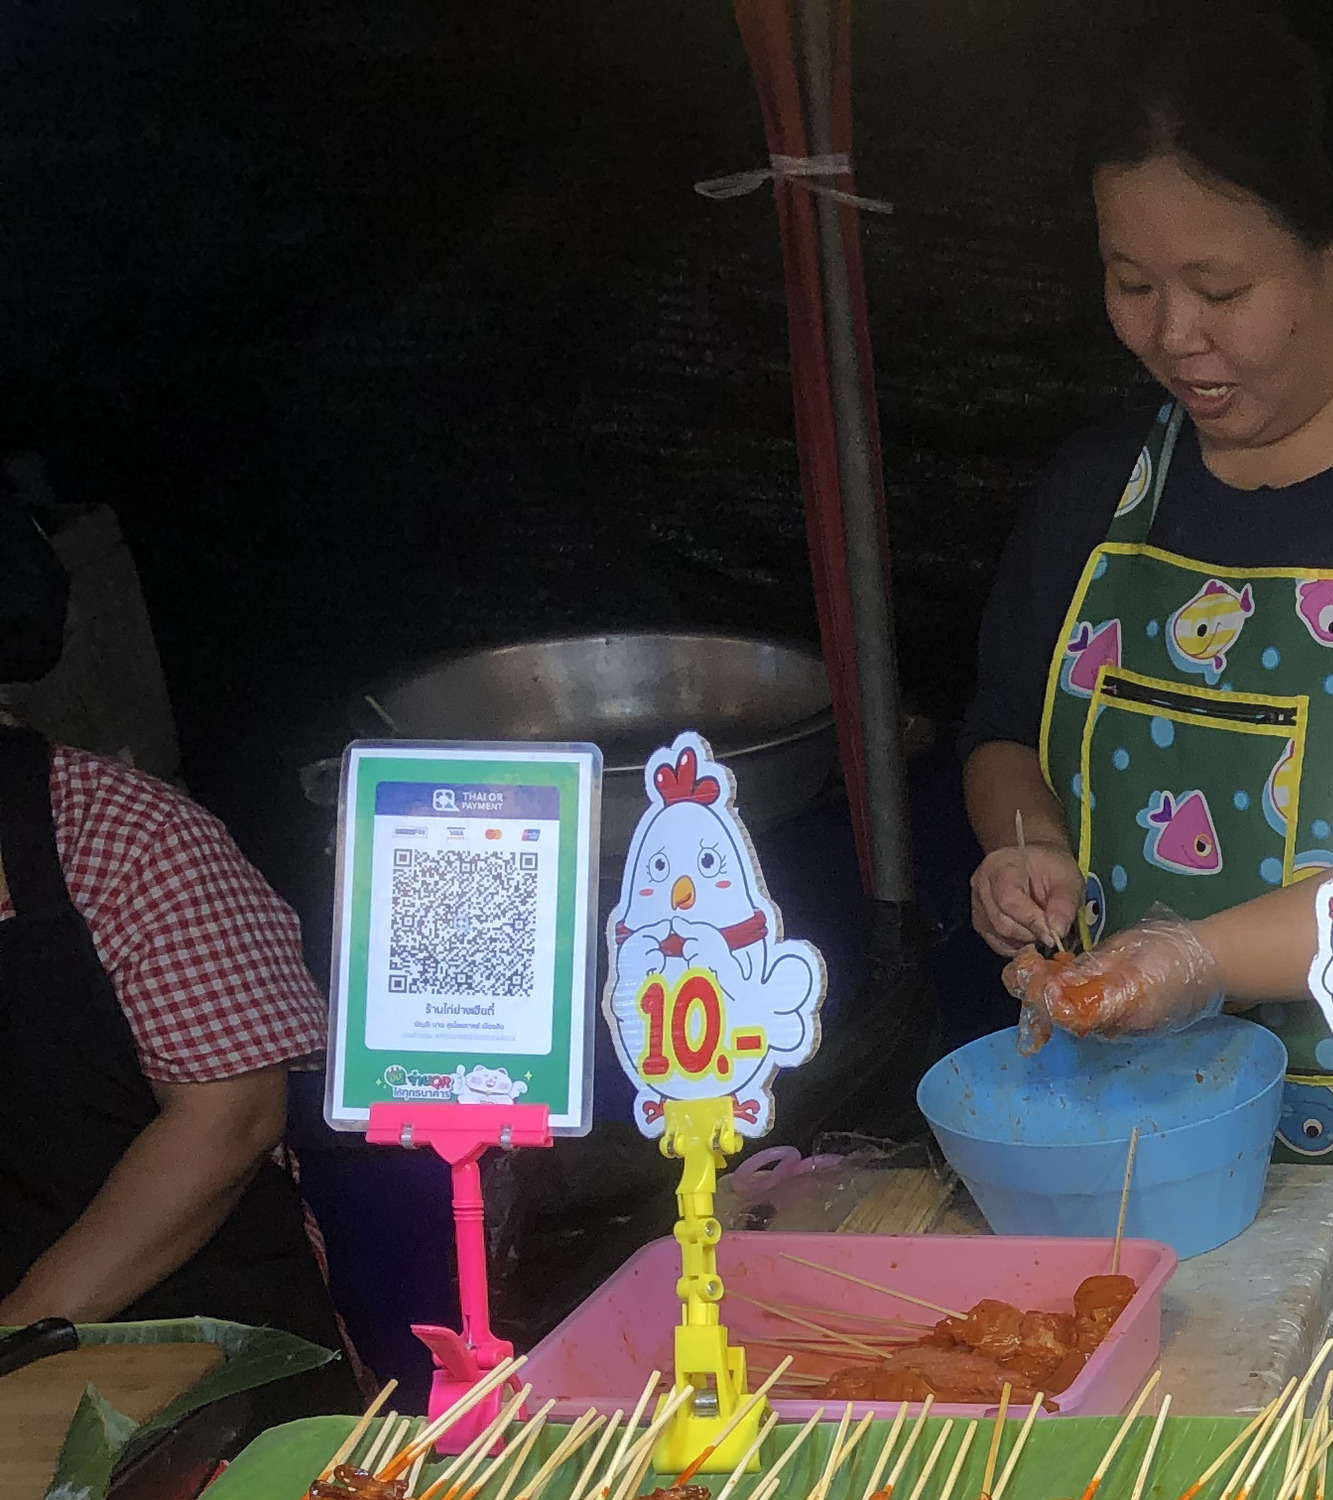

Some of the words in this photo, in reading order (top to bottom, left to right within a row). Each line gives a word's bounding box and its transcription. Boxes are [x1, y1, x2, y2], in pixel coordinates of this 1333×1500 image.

[462, 791, 486, 802] THAI
[487, 792, 504, 802] QR
[462, 802, 503, 811] PAYMENT
[639, 976, 763, 1076] 10.-
